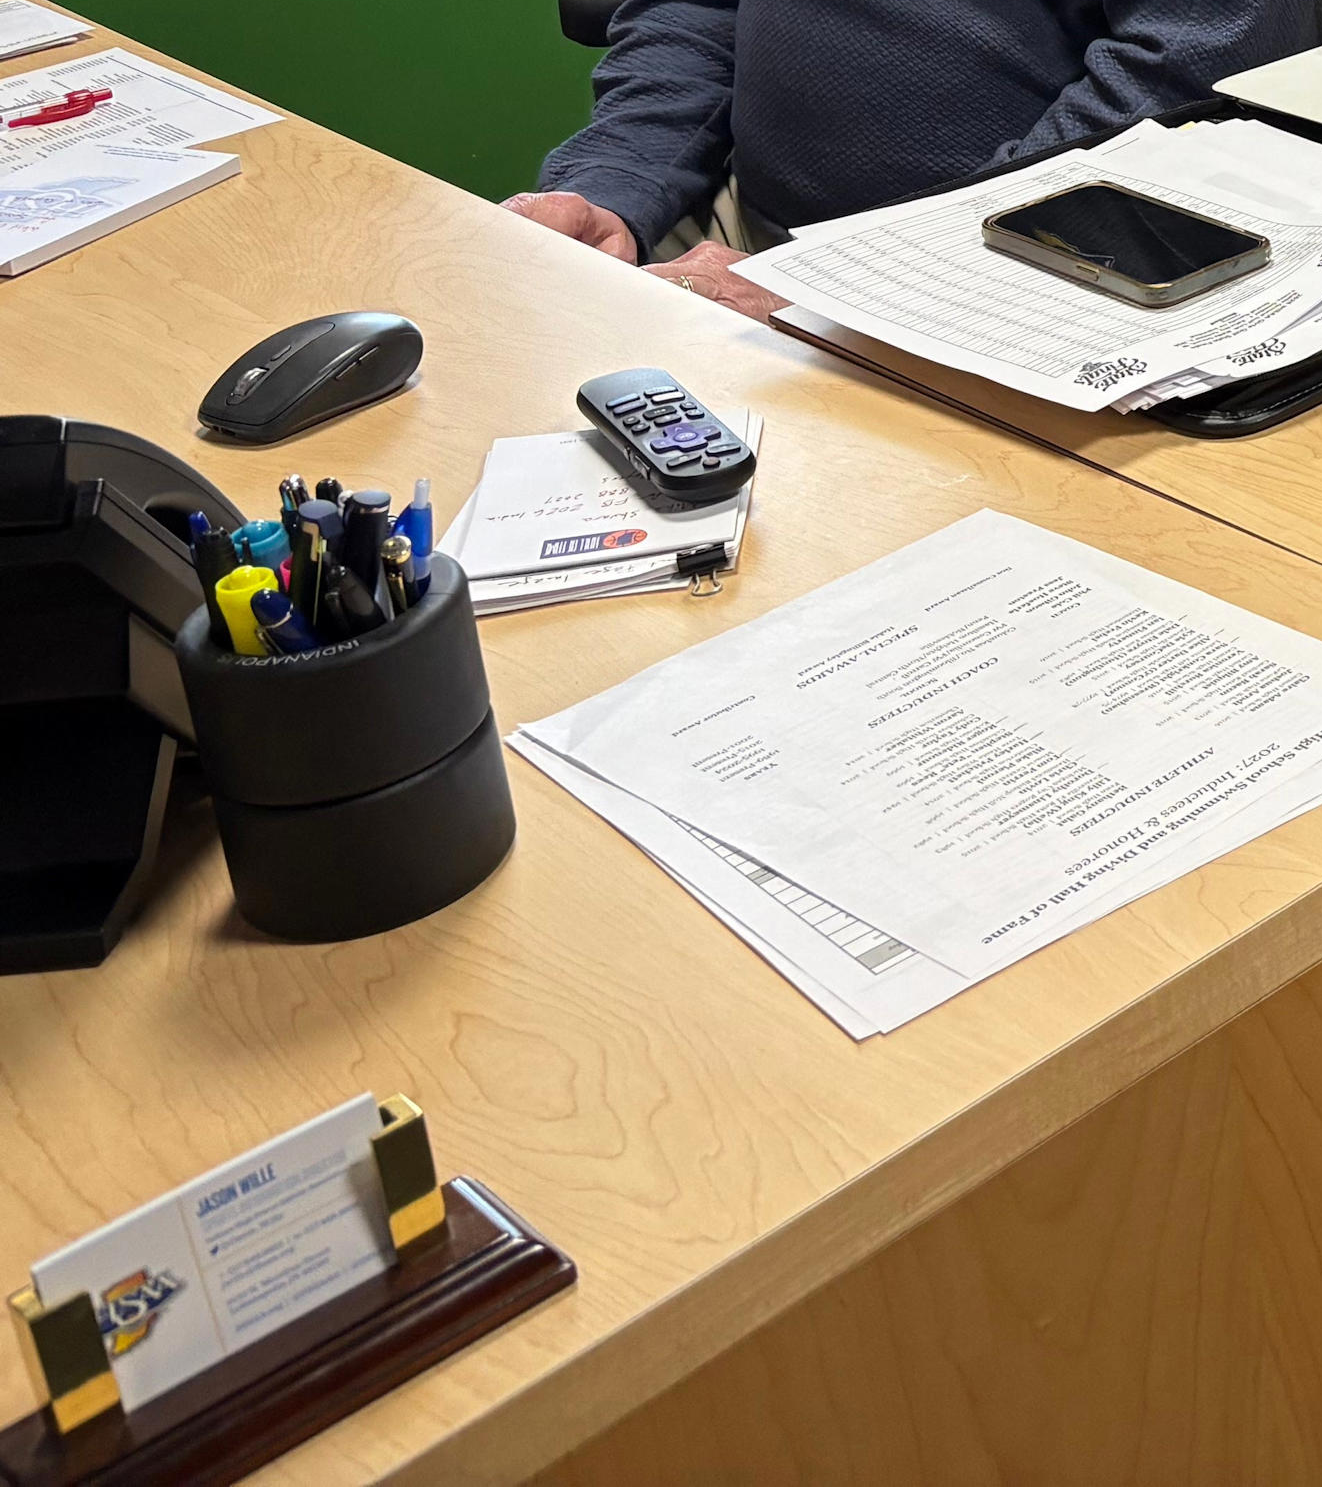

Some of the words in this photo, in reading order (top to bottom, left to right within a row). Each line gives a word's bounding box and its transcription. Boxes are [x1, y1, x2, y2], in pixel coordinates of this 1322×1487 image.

[1232, 338, 1286, 366] State
[1074, 357, 1128, 385] Finals
[1095, 359, 1147, 391] State
[858, 624, 919, 656] SPECIAL
[796, 646, 858, 690] AWARDS
[949, 657, 999, 686] COACH
[867, 679, 950, 729] INDUCTEES
[1151, 746, 1214, 788] ATHLETE
[1235, 742, 1281, 772] 2027:
[1244, 750, 1296, 783] School
[1159, 770, 1237, 818] Inductees
[1165, 781, 1248, 831] Swimming
[1069, 785, 1153, 837] INDUCTEES
[1143, 816, 1161, 828] &
[1064, 826, 1145, 876] Honorees
[1136, 830, 1168, 851] and
[1081, 848, 1139, 882] Diving
[1047, 880, 1087, 905] Hall
[1028, 903, 1048, 921] of
[981, 915, 1032, 945] Fame
[196, 1181, 239, 1219] JASON
[236, 1163, 276, 1202] WILLE
